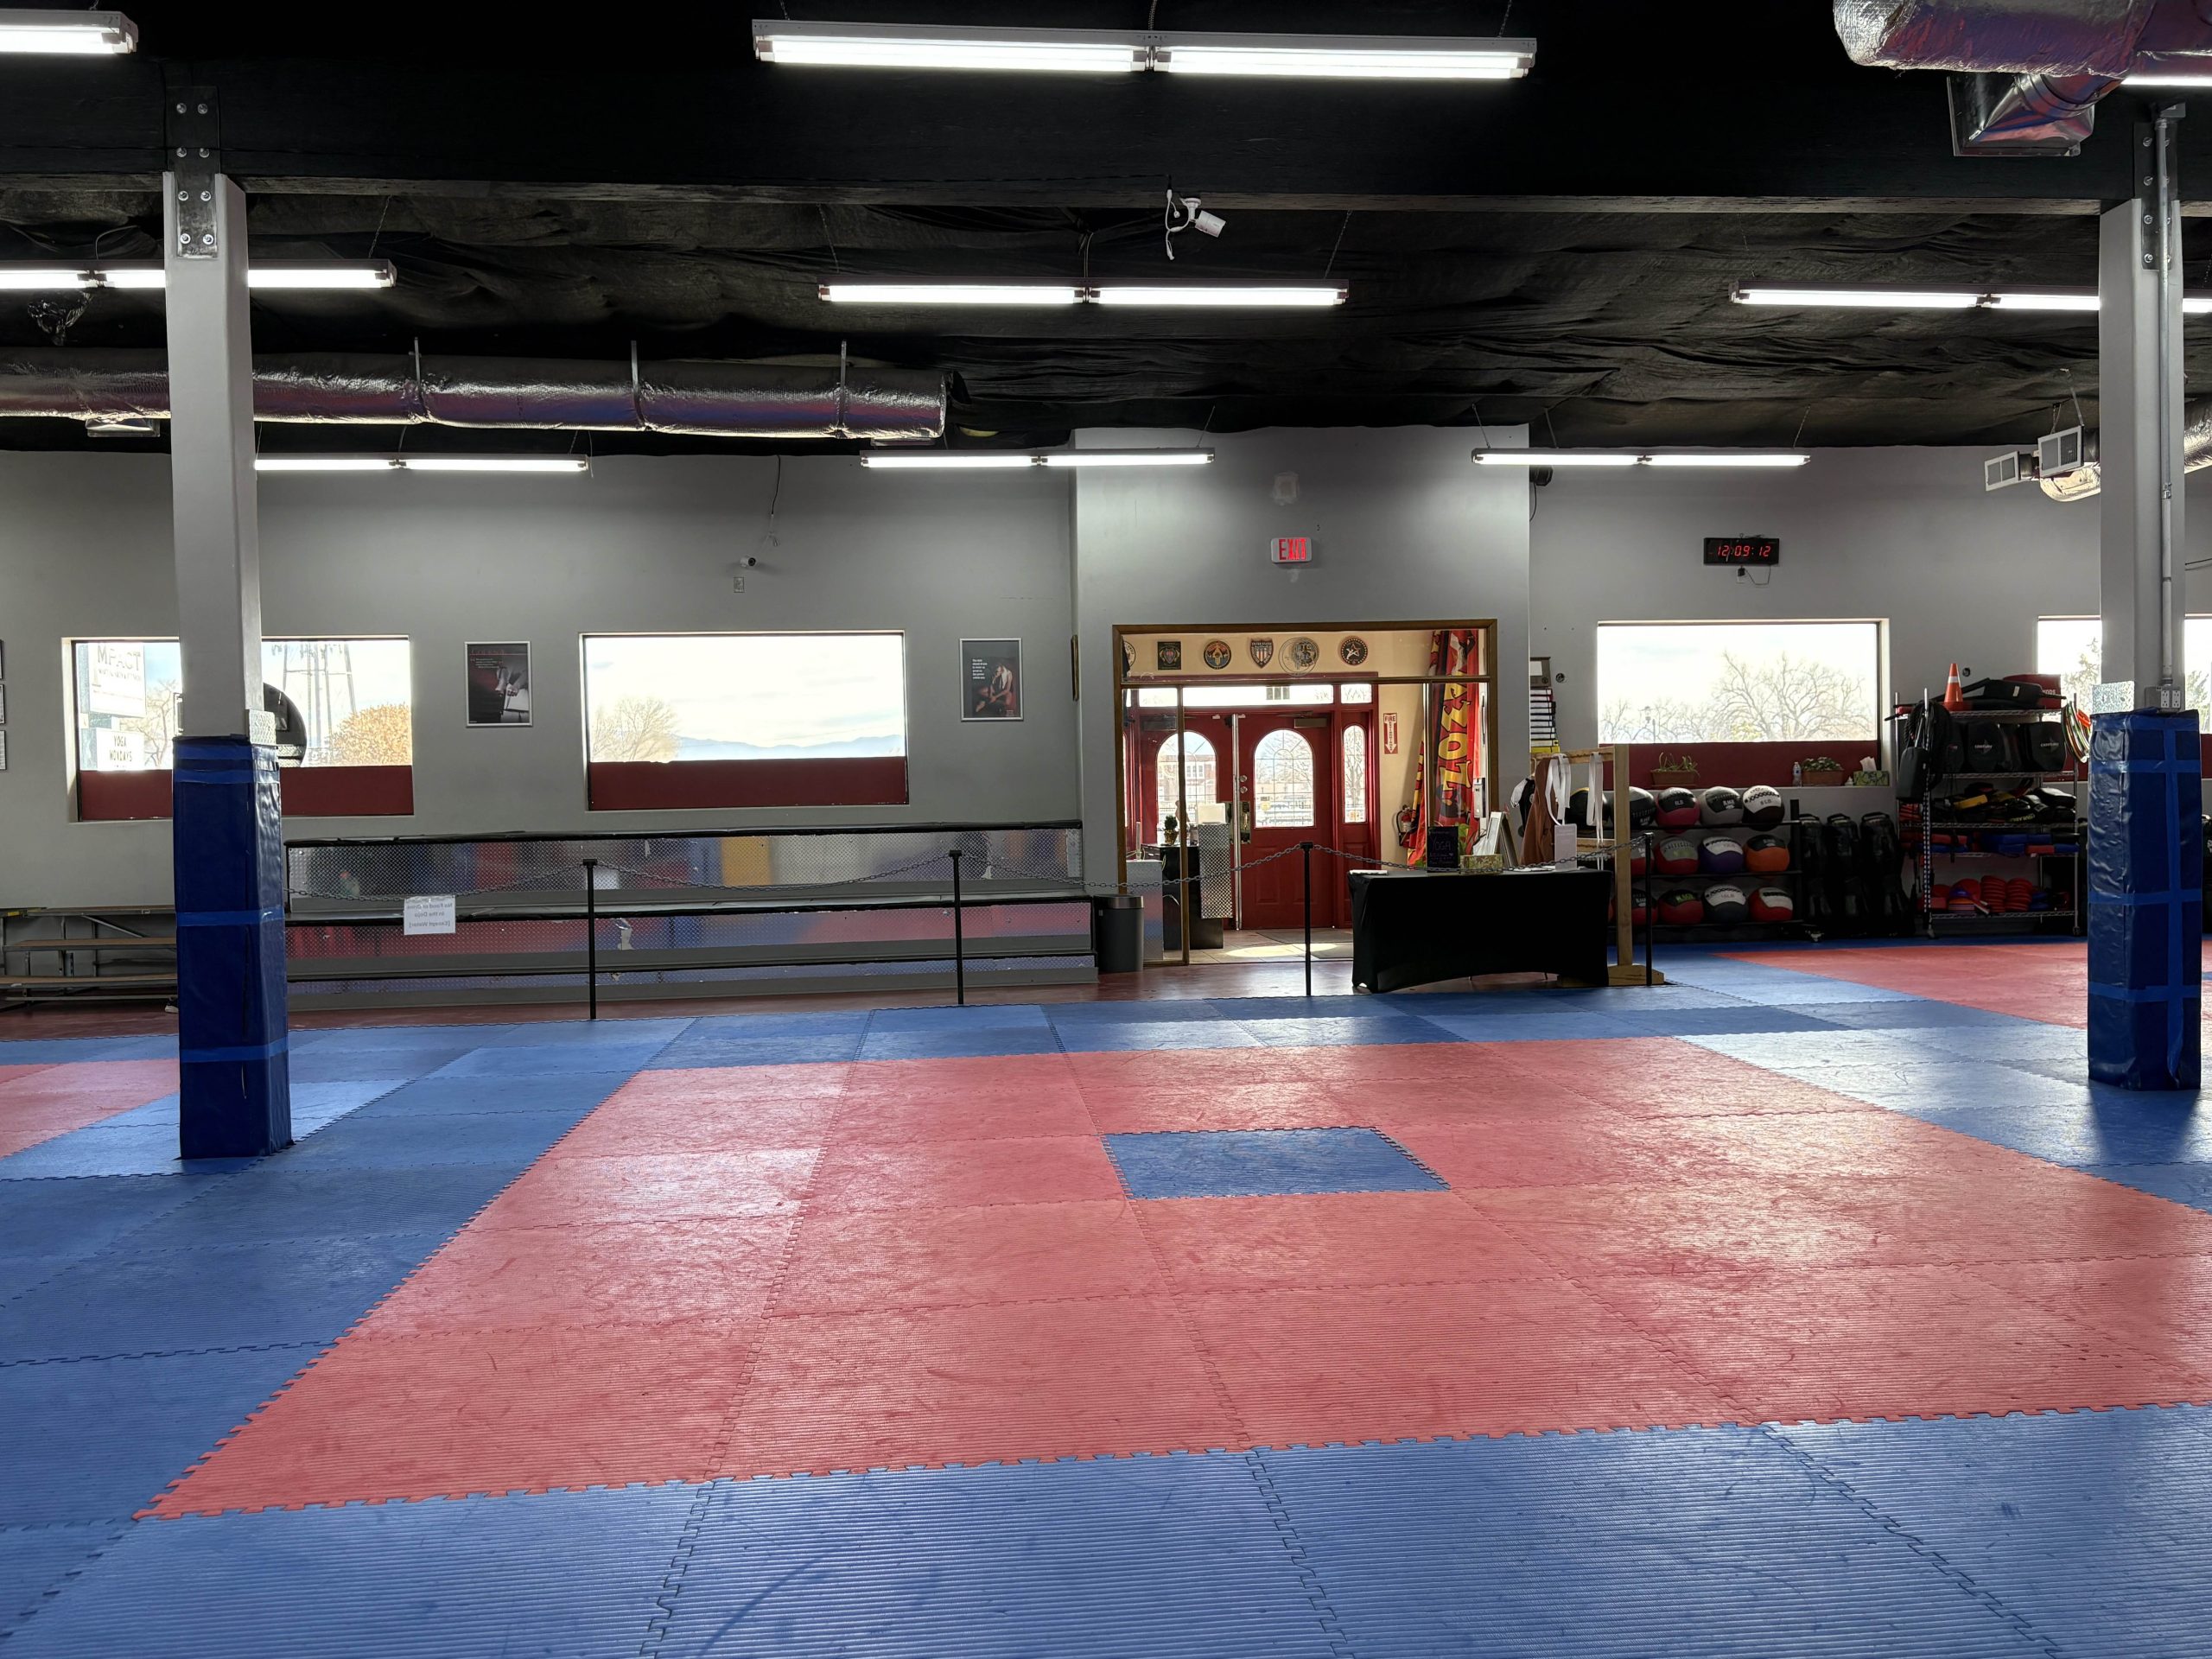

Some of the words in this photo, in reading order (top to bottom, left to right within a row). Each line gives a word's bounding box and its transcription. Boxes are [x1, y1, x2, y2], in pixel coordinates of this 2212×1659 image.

[1279, 539, 1306, 560] EXIT
[113, 734, 127, 747] YOGA
[109, 749, 132, 762] MONDAYS
